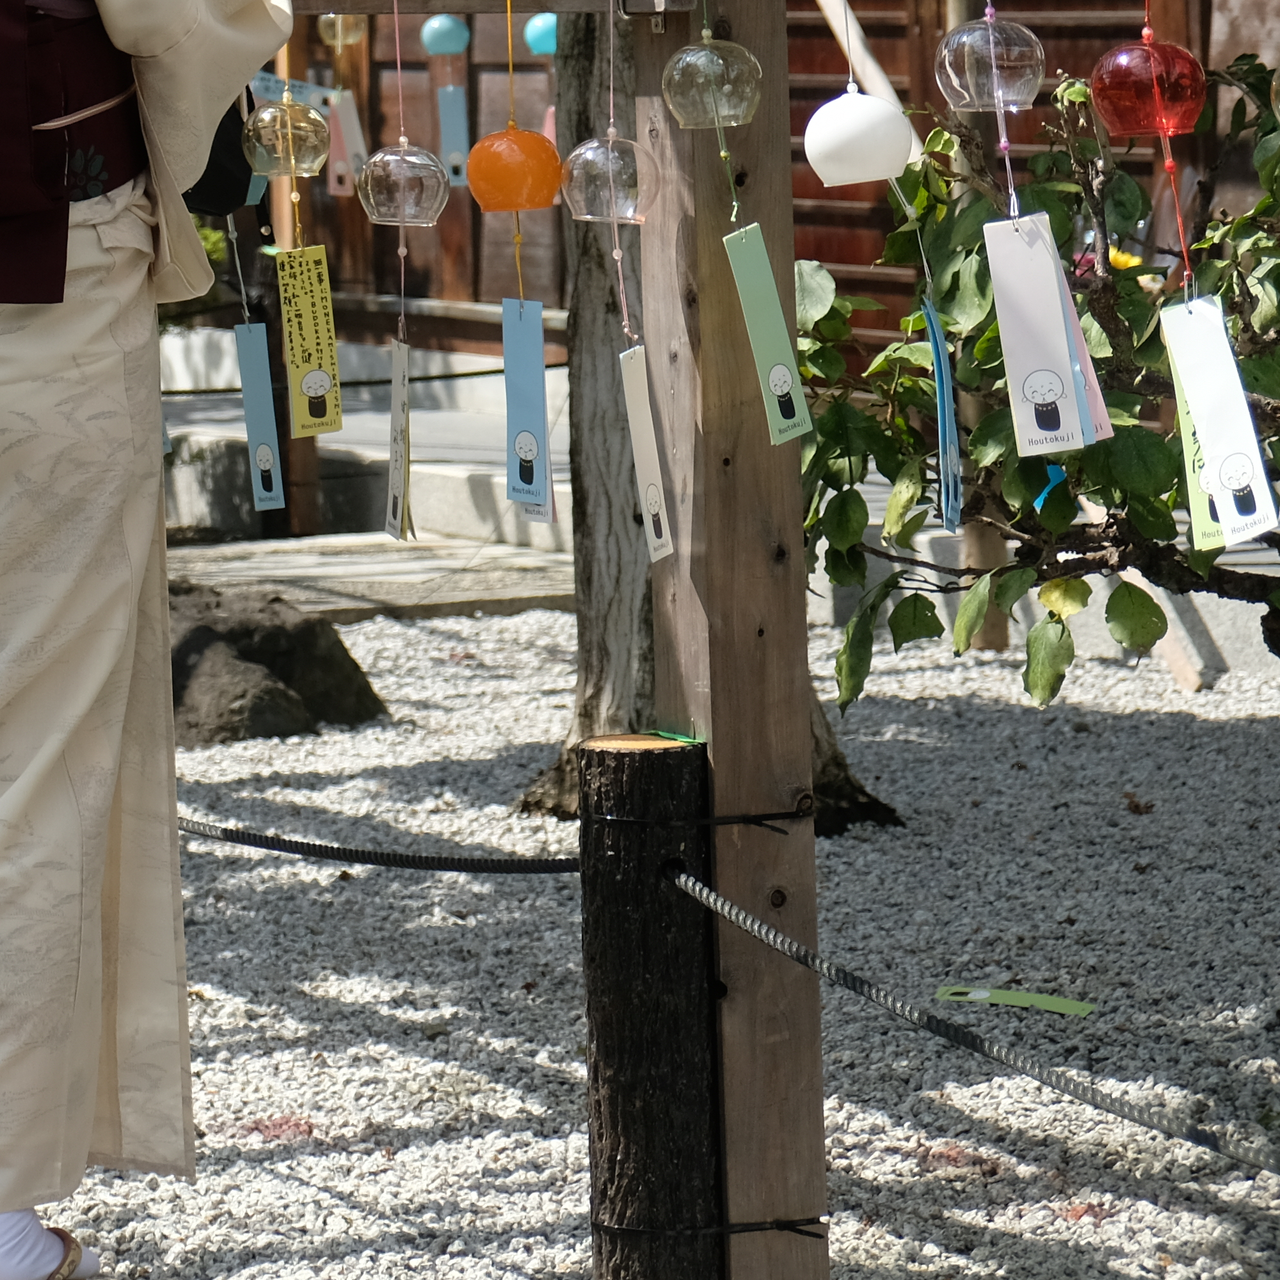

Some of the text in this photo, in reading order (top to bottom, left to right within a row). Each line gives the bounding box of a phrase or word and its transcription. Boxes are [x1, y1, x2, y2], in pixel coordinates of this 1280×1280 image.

[301, 419, 337, 431] Houtokuji
[777, 416, 808, 435] Houtokuji
[1027, 432, 1076, 447] Houtokuji
[511, 484, 542, 498] Houtokuji
[1231, 515, 1271, 536] Houtokuji
